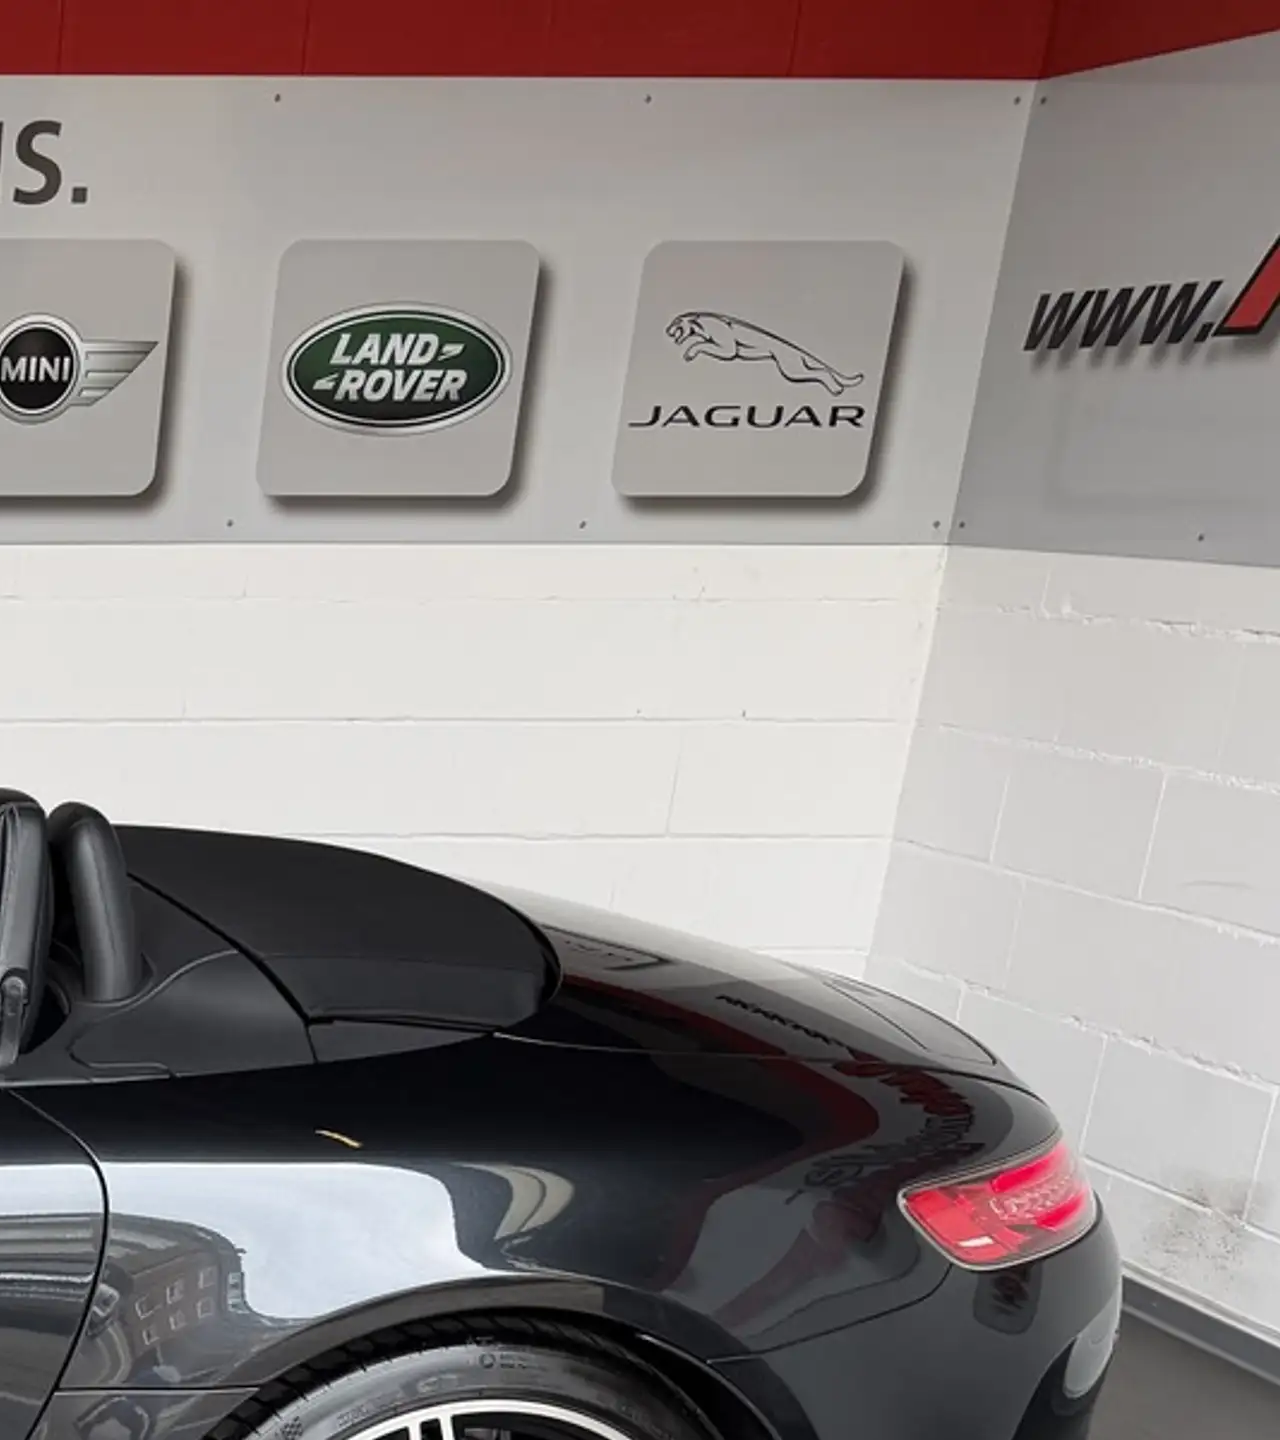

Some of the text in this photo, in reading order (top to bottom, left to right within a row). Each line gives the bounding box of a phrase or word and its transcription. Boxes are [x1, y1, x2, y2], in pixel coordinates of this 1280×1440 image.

[329, 333, 439, 365] LAND
[1, 356, 71, 382] MINI
[334, 369, 467, 400] ROVER
[629, 405, 866, 428] JAGUAR
